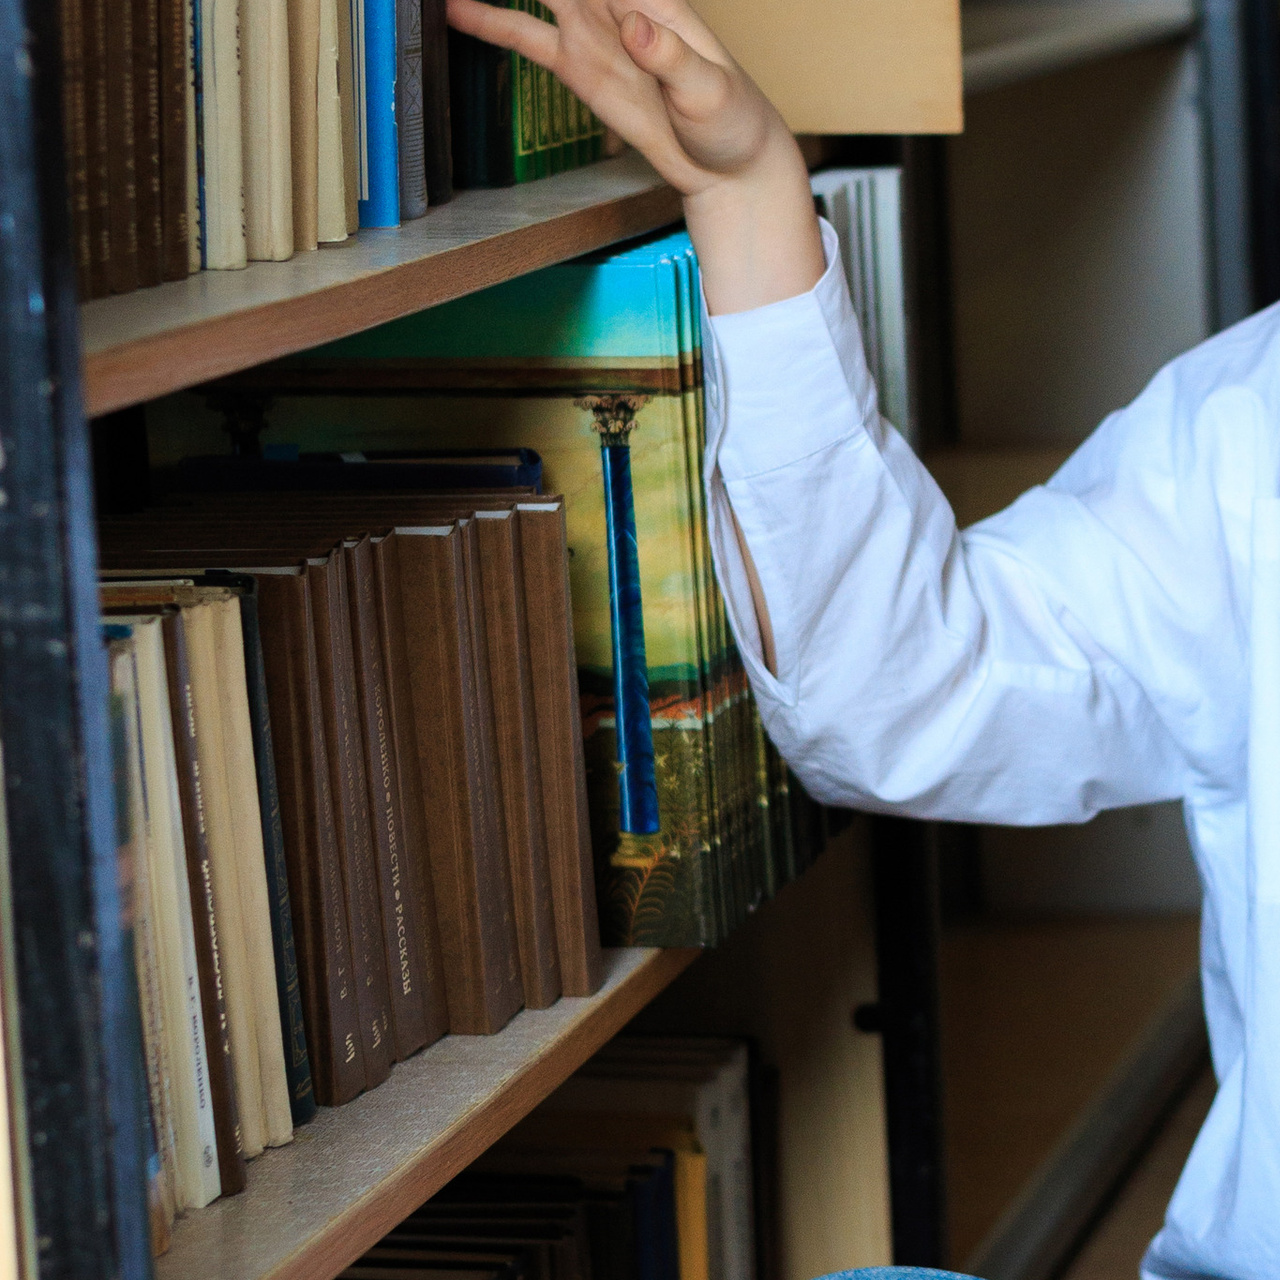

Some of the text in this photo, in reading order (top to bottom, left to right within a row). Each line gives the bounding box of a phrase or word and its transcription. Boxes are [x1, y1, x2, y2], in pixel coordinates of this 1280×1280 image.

[373, 683, 391, 789] КОРОЛЕНКО
[385, 805, 401, 888] ПОВЕСТИ
[394, 903, 412, 996] РАССКАЗЫ
